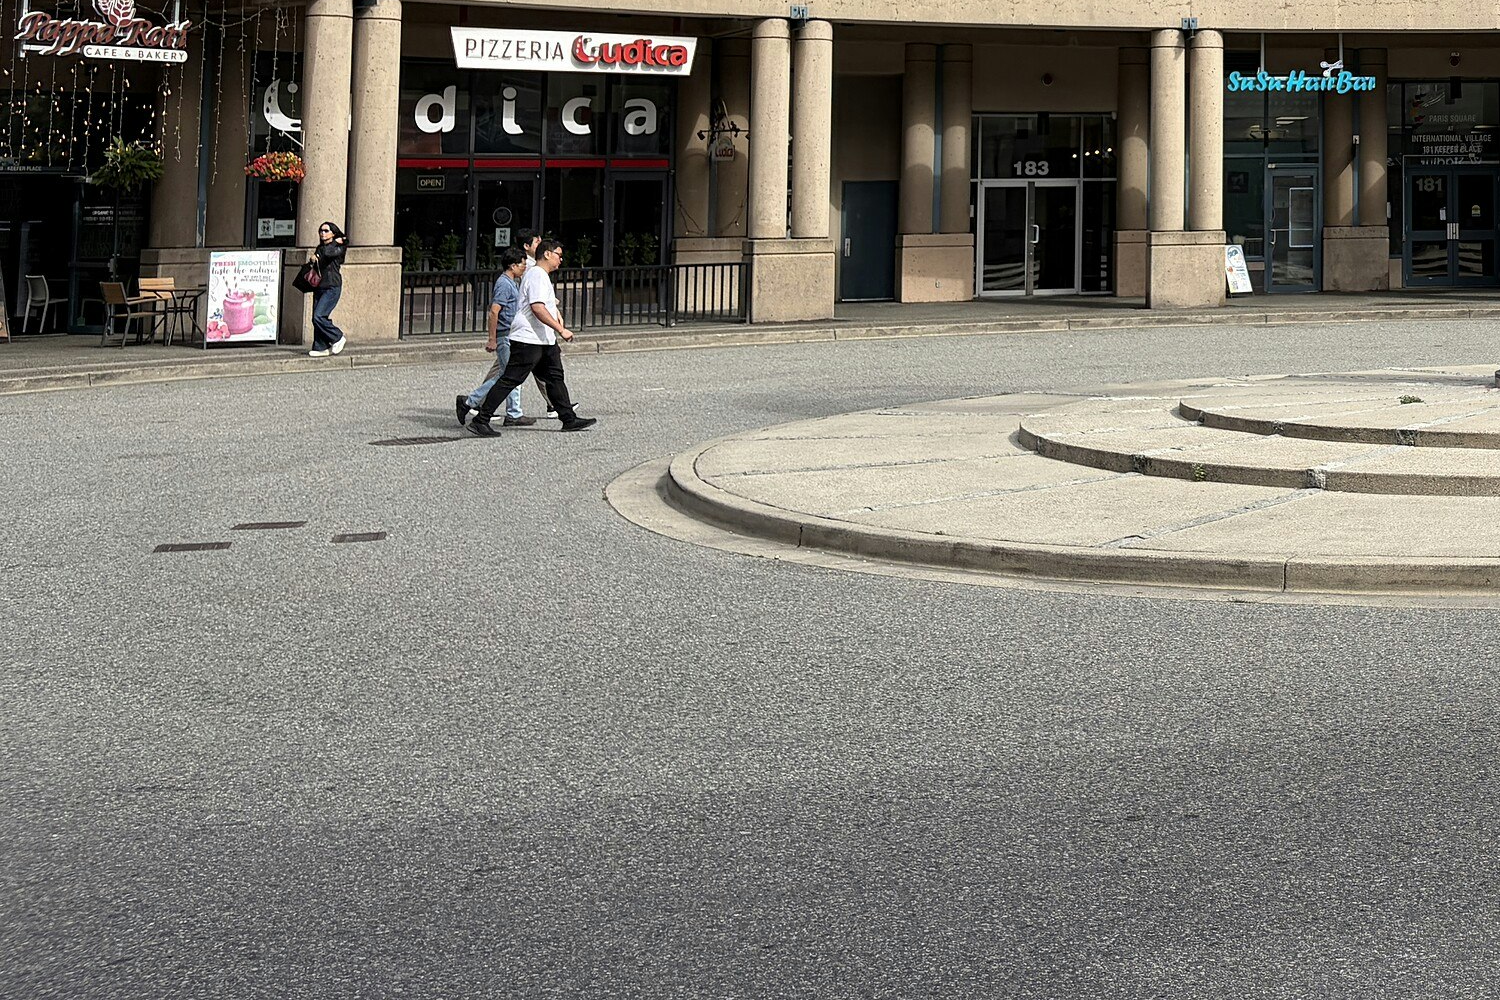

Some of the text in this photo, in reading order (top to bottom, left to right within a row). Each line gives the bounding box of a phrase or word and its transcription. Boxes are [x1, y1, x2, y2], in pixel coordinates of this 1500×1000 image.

[14, 12, 192, 55] Pappa Roti
[85, 46, 186, 62] CAFE & BAKERY
[465, 38, 564, 61] PIZZERIA
[1428, 114, 1476, 122] PARIS SQUARE
[1411, 134, 1492, 143] INTERNATIONAL VILLAGE
[1013, 160, 1049, 176] 183
[420, 179, 442, 187] OPEN
[1416, 178, 1443, 192] 181
